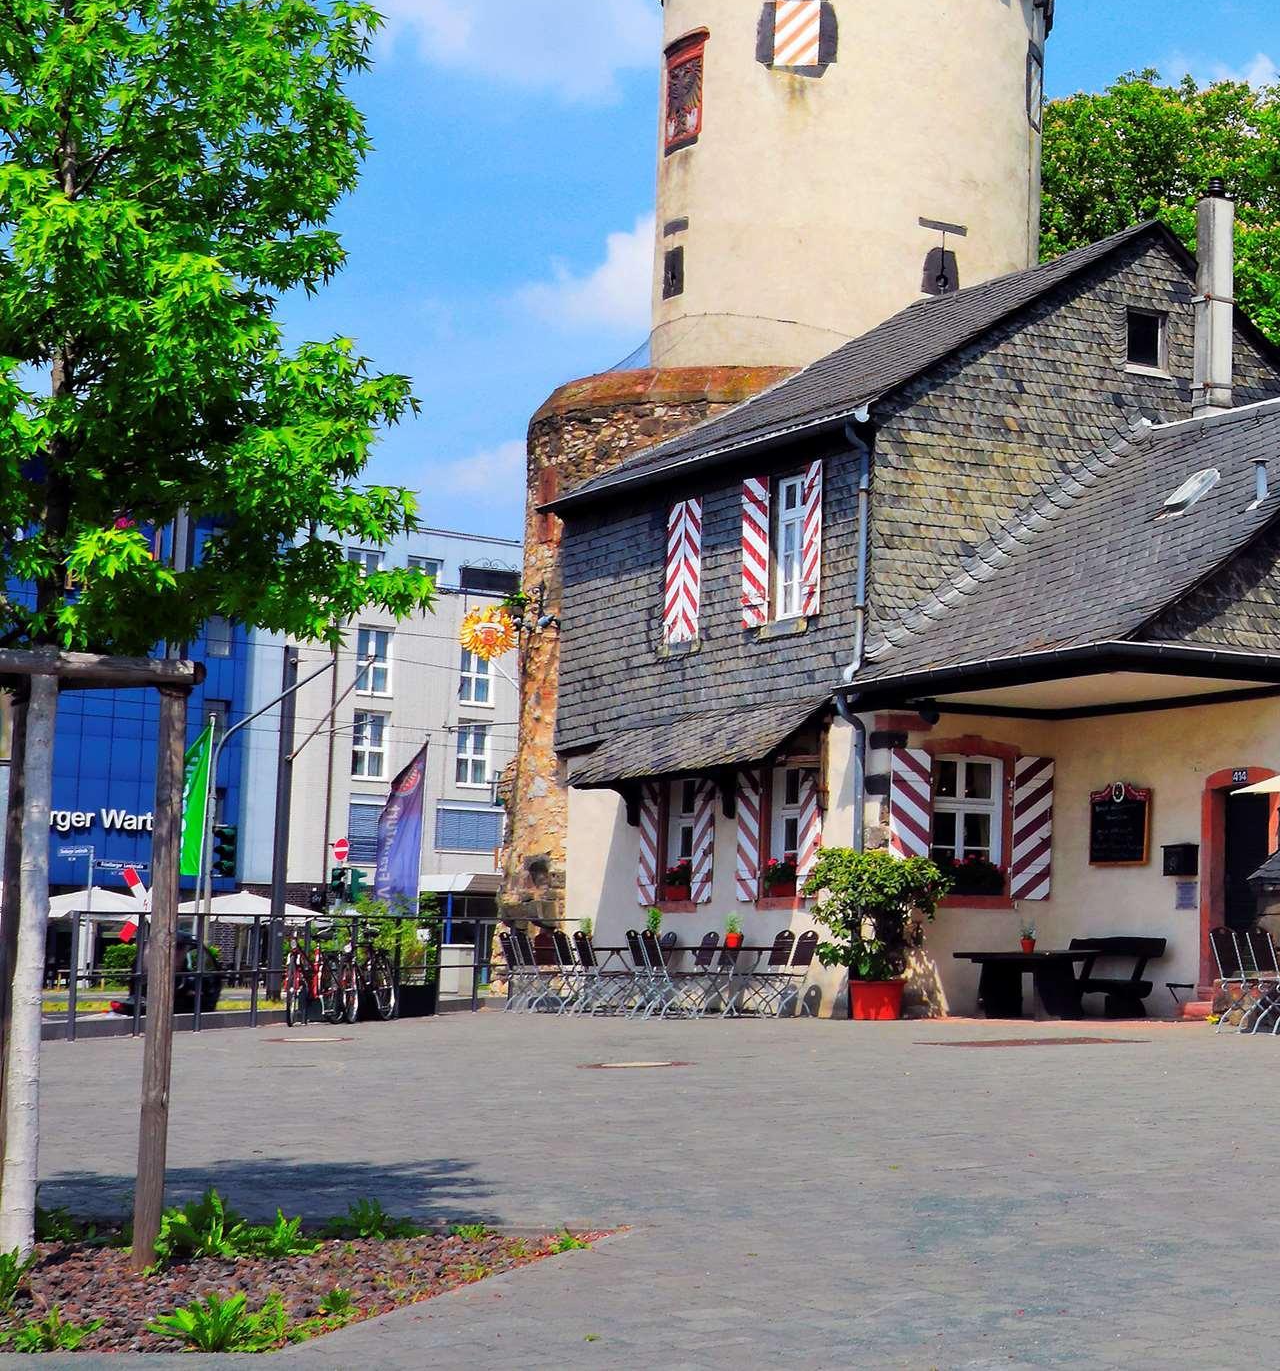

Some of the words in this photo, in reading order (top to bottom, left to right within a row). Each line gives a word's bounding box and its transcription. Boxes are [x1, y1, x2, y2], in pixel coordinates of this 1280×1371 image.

[1232, 771, 1246, 782] 414
[49, 810, 95, 832] rger
[101, 808, 153, 831] Wart
